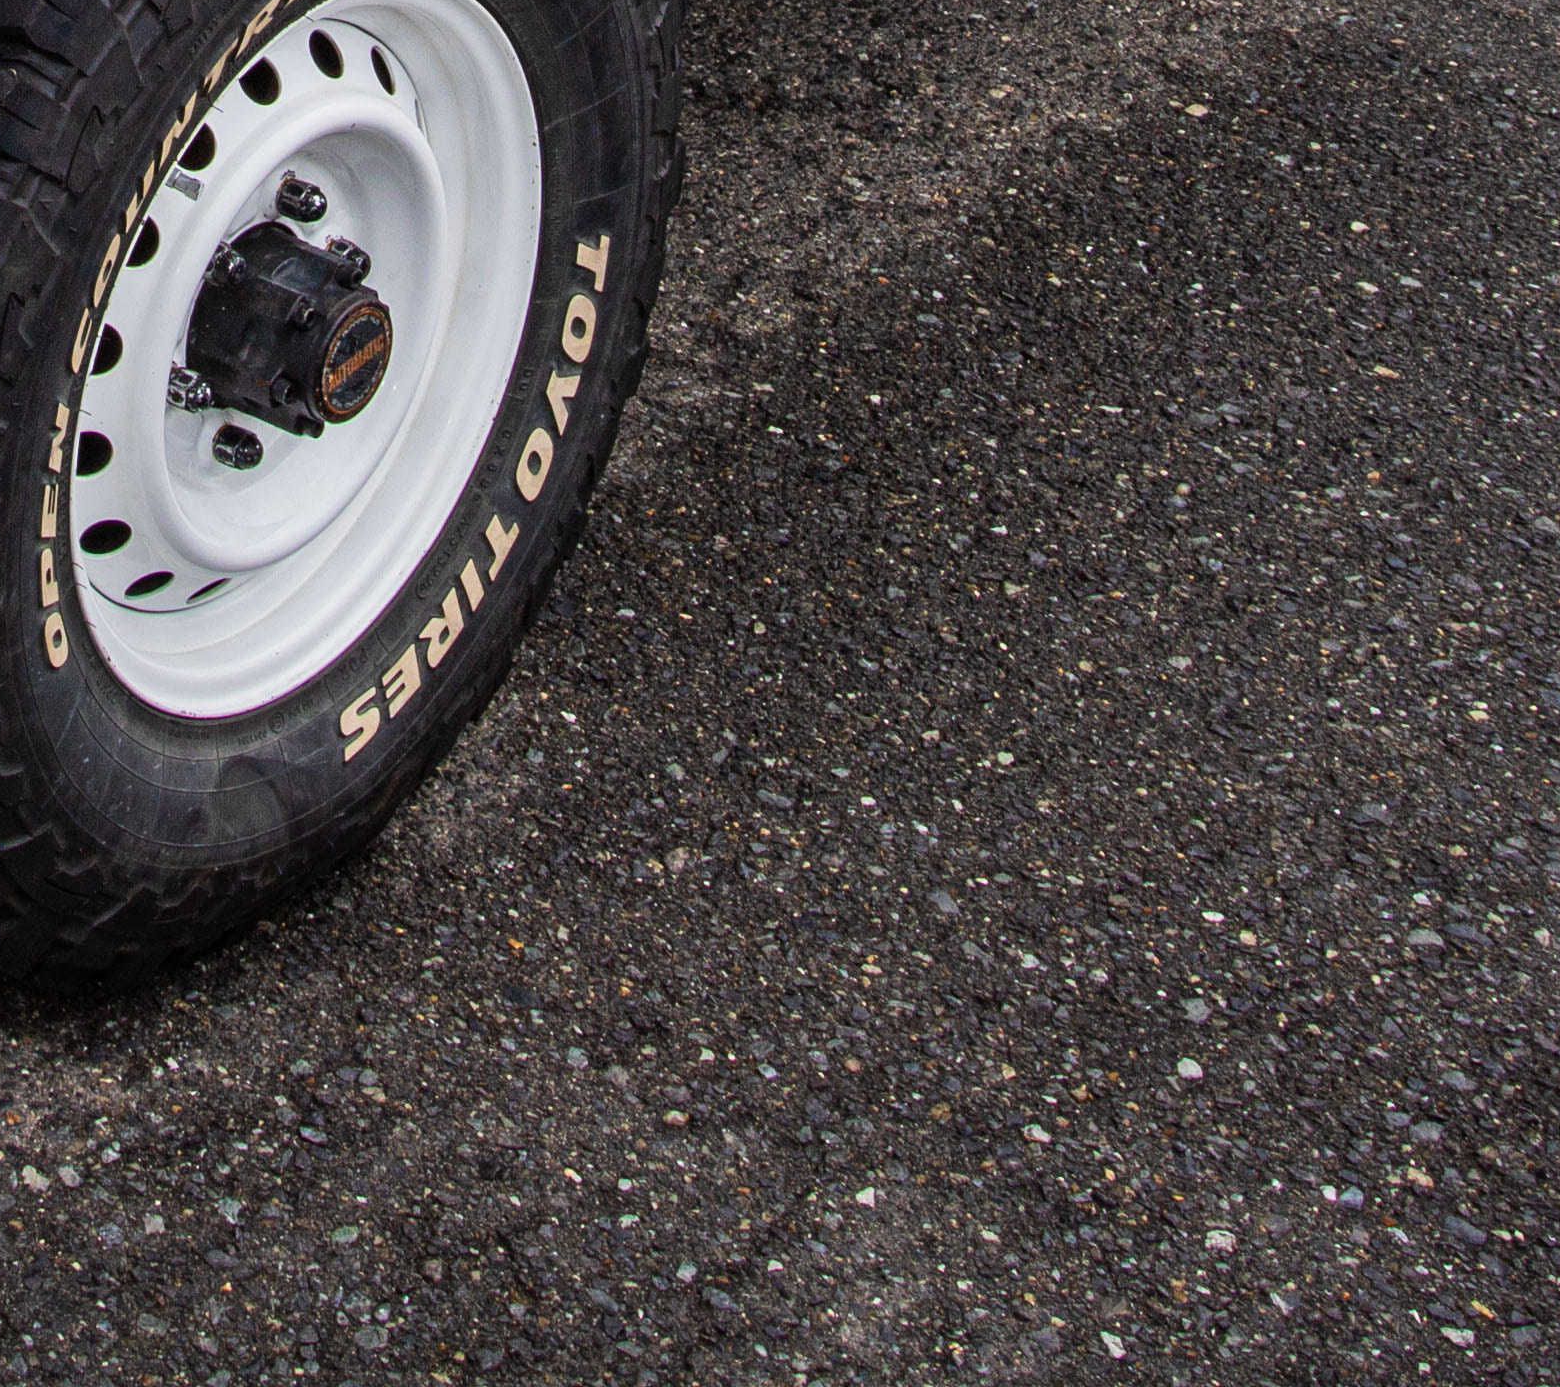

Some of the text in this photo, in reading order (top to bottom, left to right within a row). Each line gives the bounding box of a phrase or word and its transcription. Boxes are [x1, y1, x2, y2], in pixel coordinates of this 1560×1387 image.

[40, 401, 70, 668] OPEN
[339, 234, 610, 762] TOYO TIRES
